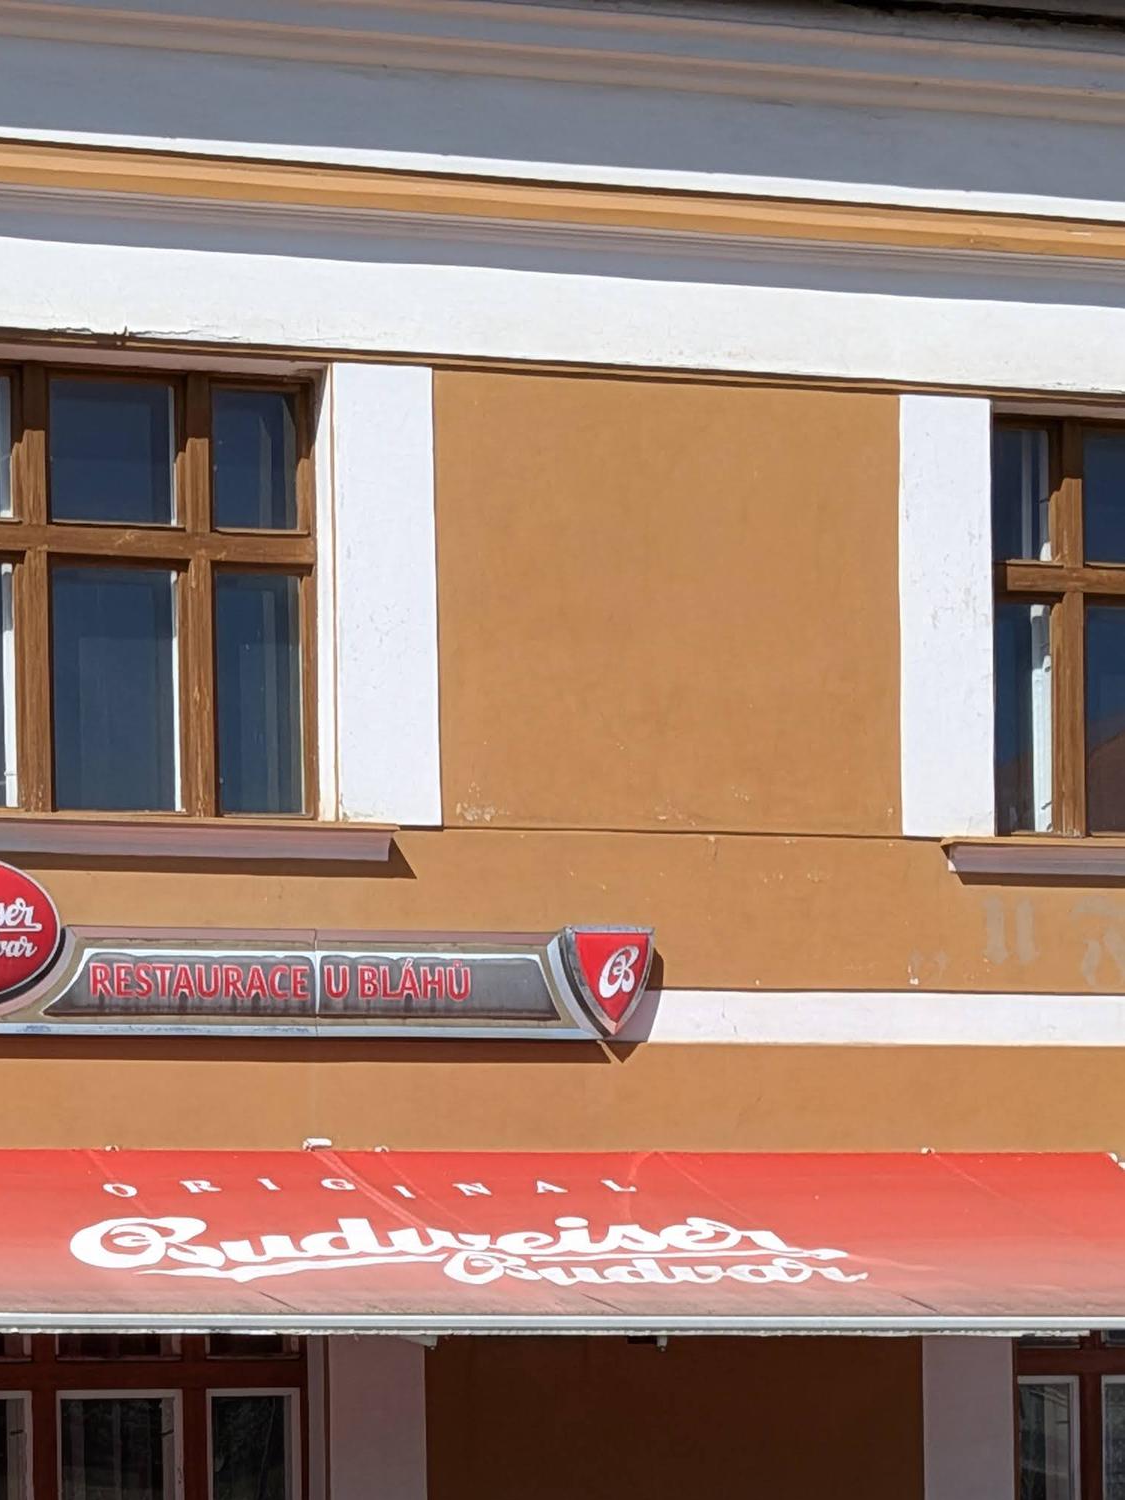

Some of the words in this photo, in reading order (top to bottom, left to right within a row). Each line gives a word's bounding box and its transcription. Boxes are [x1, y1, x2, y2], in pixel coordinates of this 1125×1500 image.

[90, 963, 311, 1001] RESTAURACE
[323, 962, 350, 1001] U
[357, 957, 472, 1002] BLÁHŮ
[102, 1177, 637, 1199] ORIGINAL
[69, 1216, 850, 1283] Budweiser
[443, 1251, 869, 1286] Budvar
